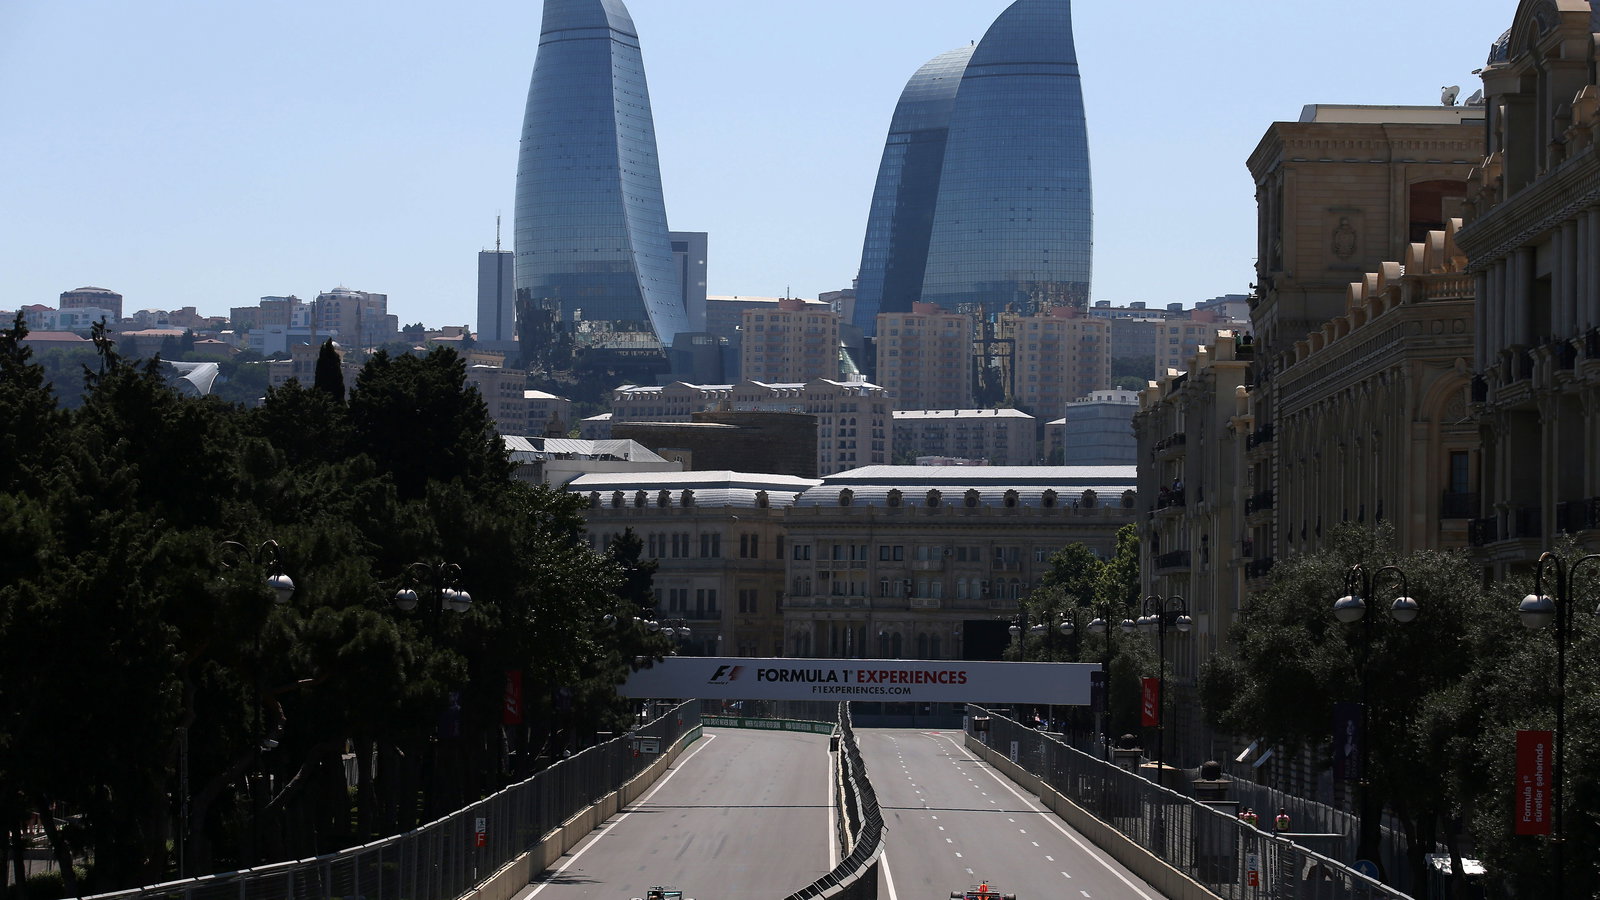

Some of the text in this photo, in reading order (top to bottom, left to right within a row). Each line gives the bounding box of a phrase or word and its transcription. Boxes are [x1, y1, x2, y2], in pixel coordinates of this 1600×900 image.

[757, 668, 838, 683] FORMULA
[857, 670, 968, 685] EXPERIENCES
[812, 686, 912, 695] F1EXPERIENCES.COM
[1523, 786, 1532, 823] Formula
[477, 833, 484, 846] F
[1249, 872, 1256, 885] F
